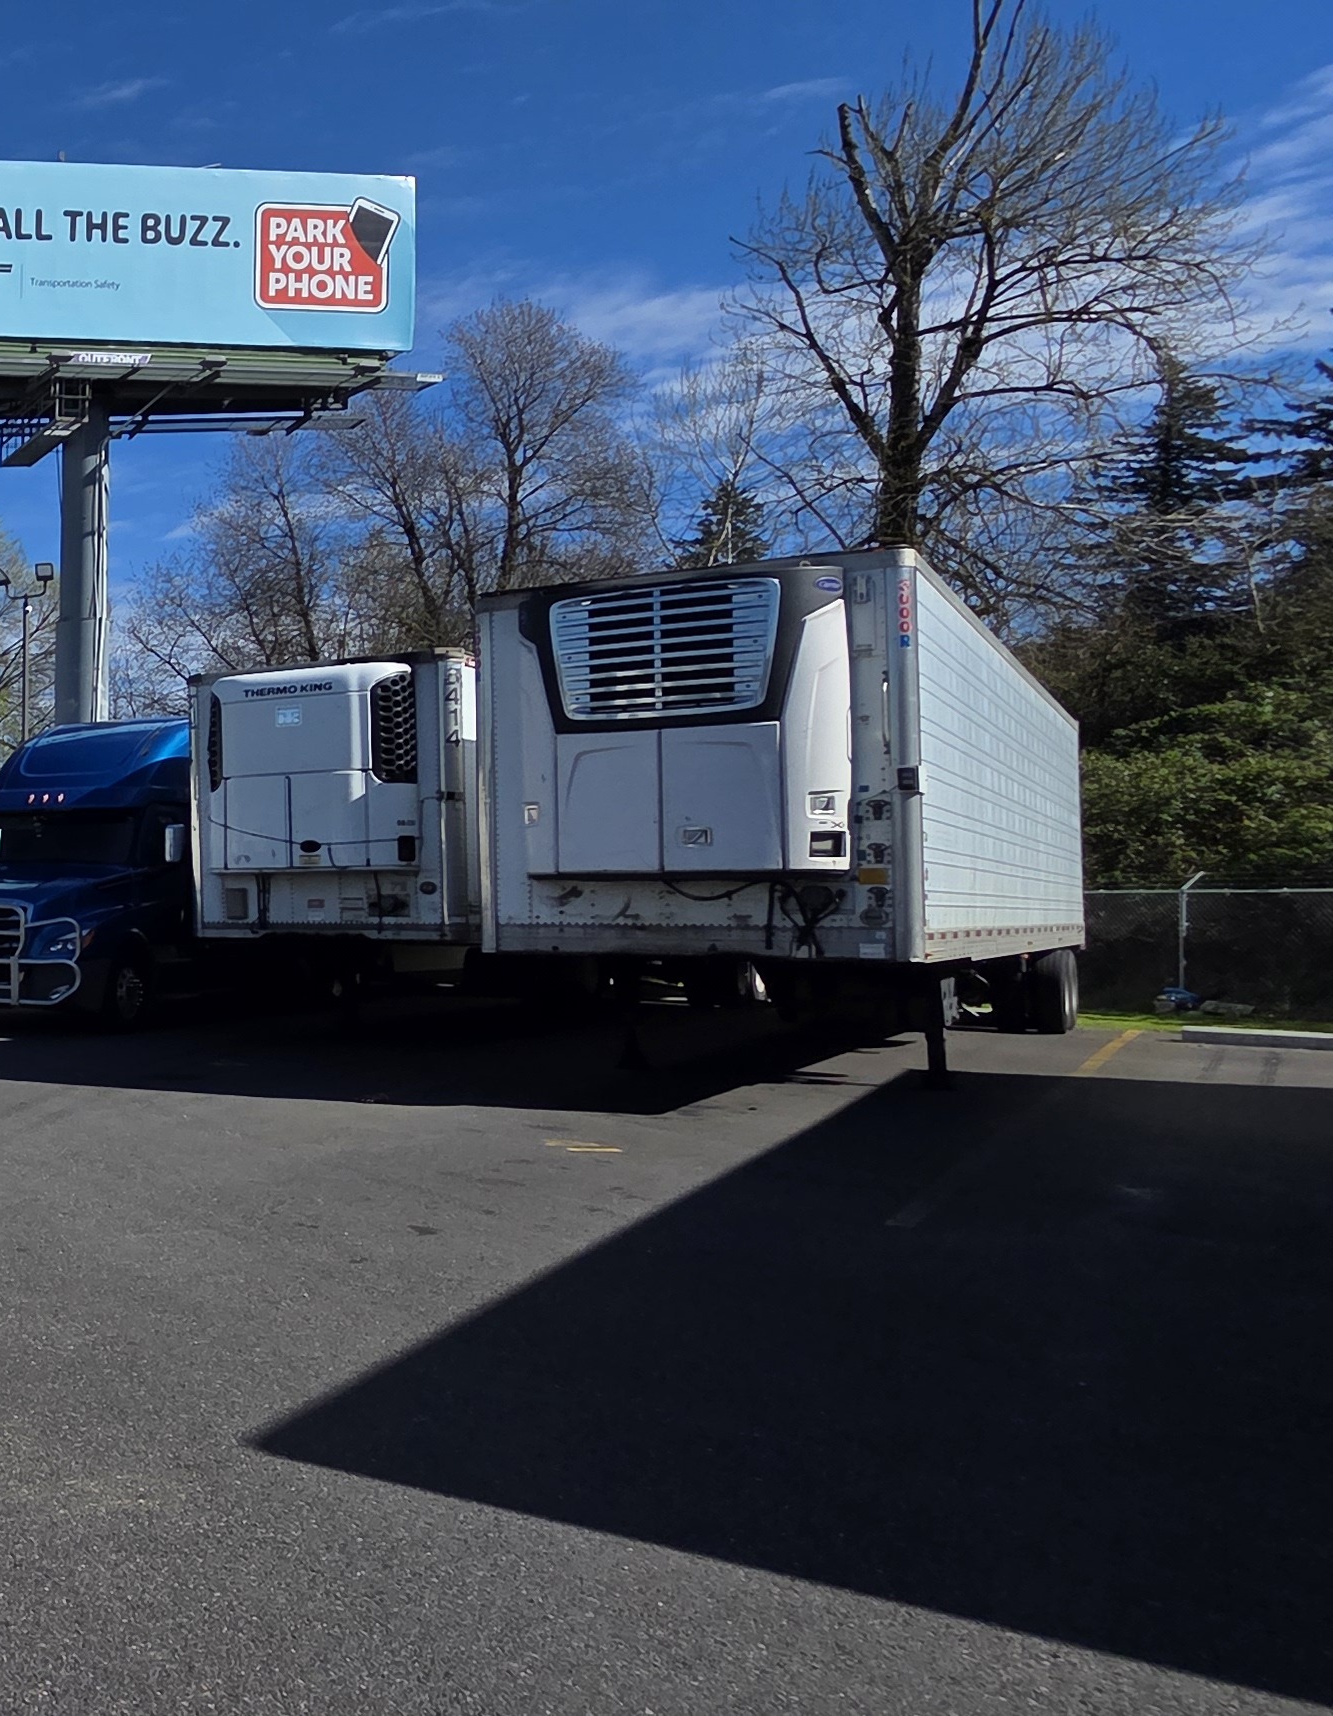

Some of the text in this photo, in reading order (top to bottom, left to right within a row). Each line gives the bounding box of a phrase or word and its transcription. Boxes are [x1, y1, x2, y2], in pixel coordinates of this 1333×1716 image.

[63, 209, 130, 244] THE
[140, 213, 241, 249] BUZZ.
[268, 217, 346, 244] PARK
[268, 244, 352, 272] YOUR
[30, 277, 121, 291] Transportation Safety
[268, 272, 374, 300] PHONE
[243, 681, 333, 698] THERMO KING
